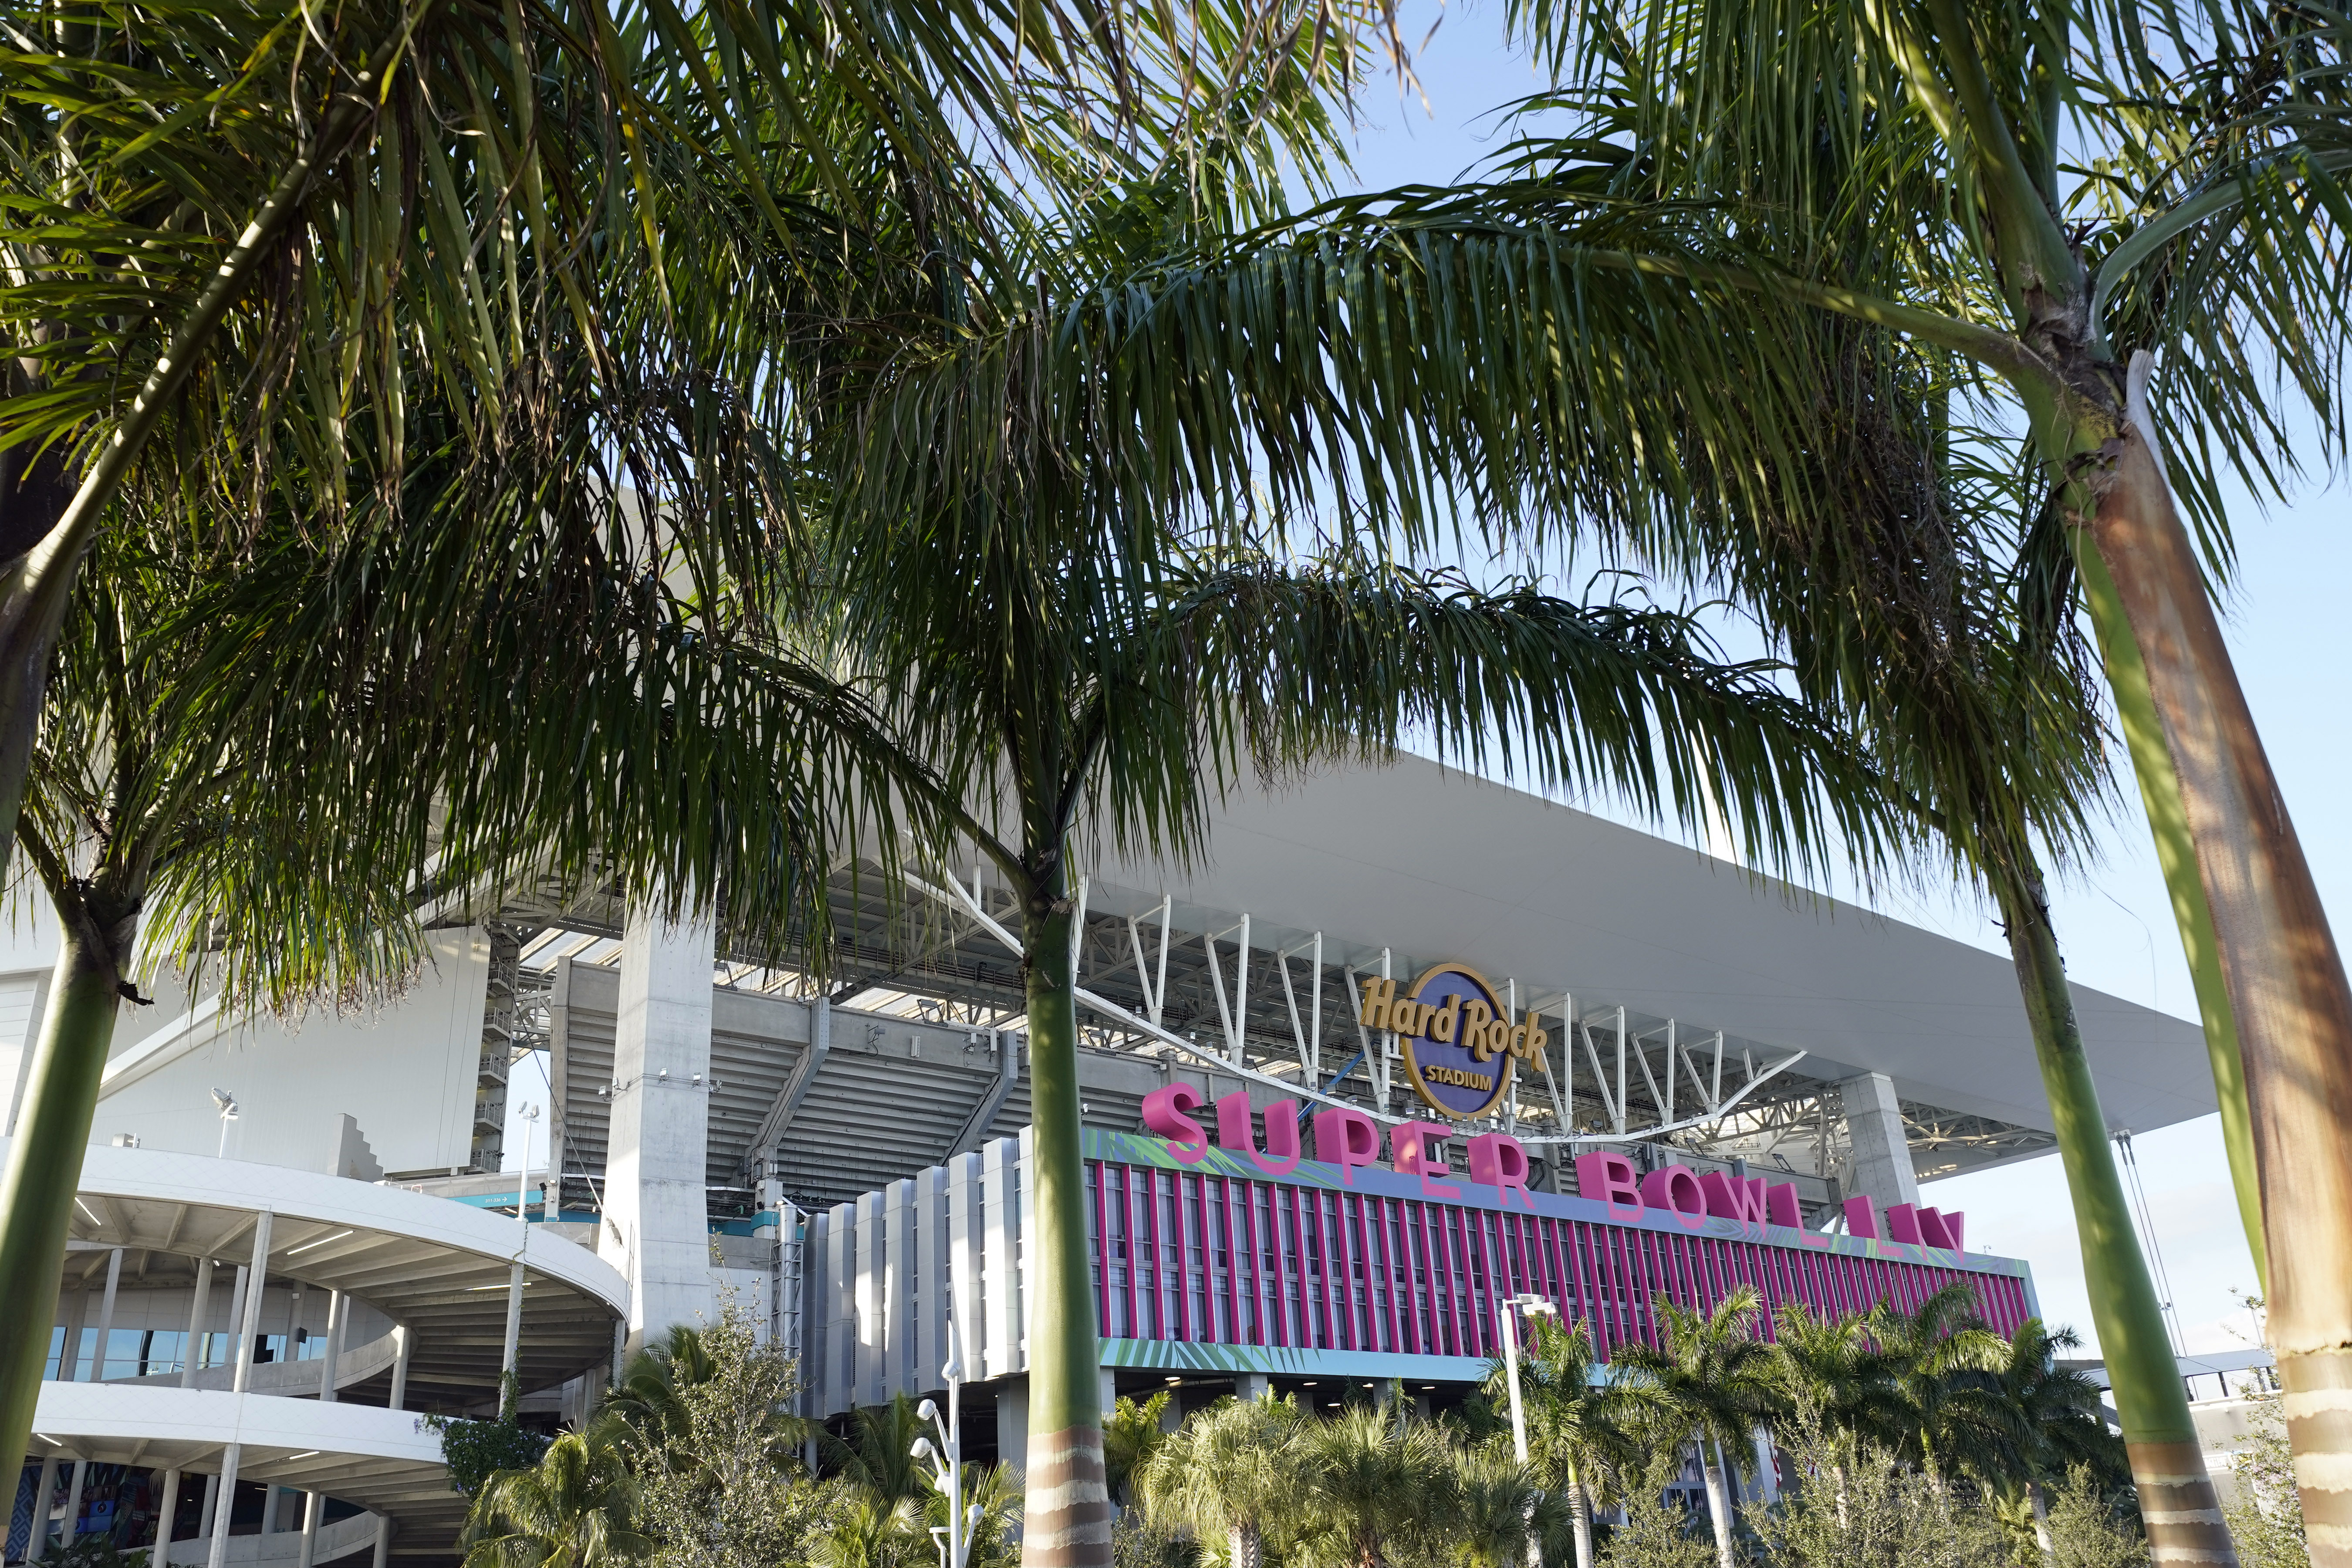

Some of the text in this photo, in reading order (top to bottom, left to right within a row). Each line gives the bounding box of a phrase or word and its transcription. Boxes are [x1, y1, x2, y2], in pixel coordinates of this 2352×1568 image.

[1359, 976, 1548, 1072] Hard Rock
[1425, 1065, 1492, 1091] STADIUM
[1142, 1081, 1964, 1264] SUPER BOWL LIV
